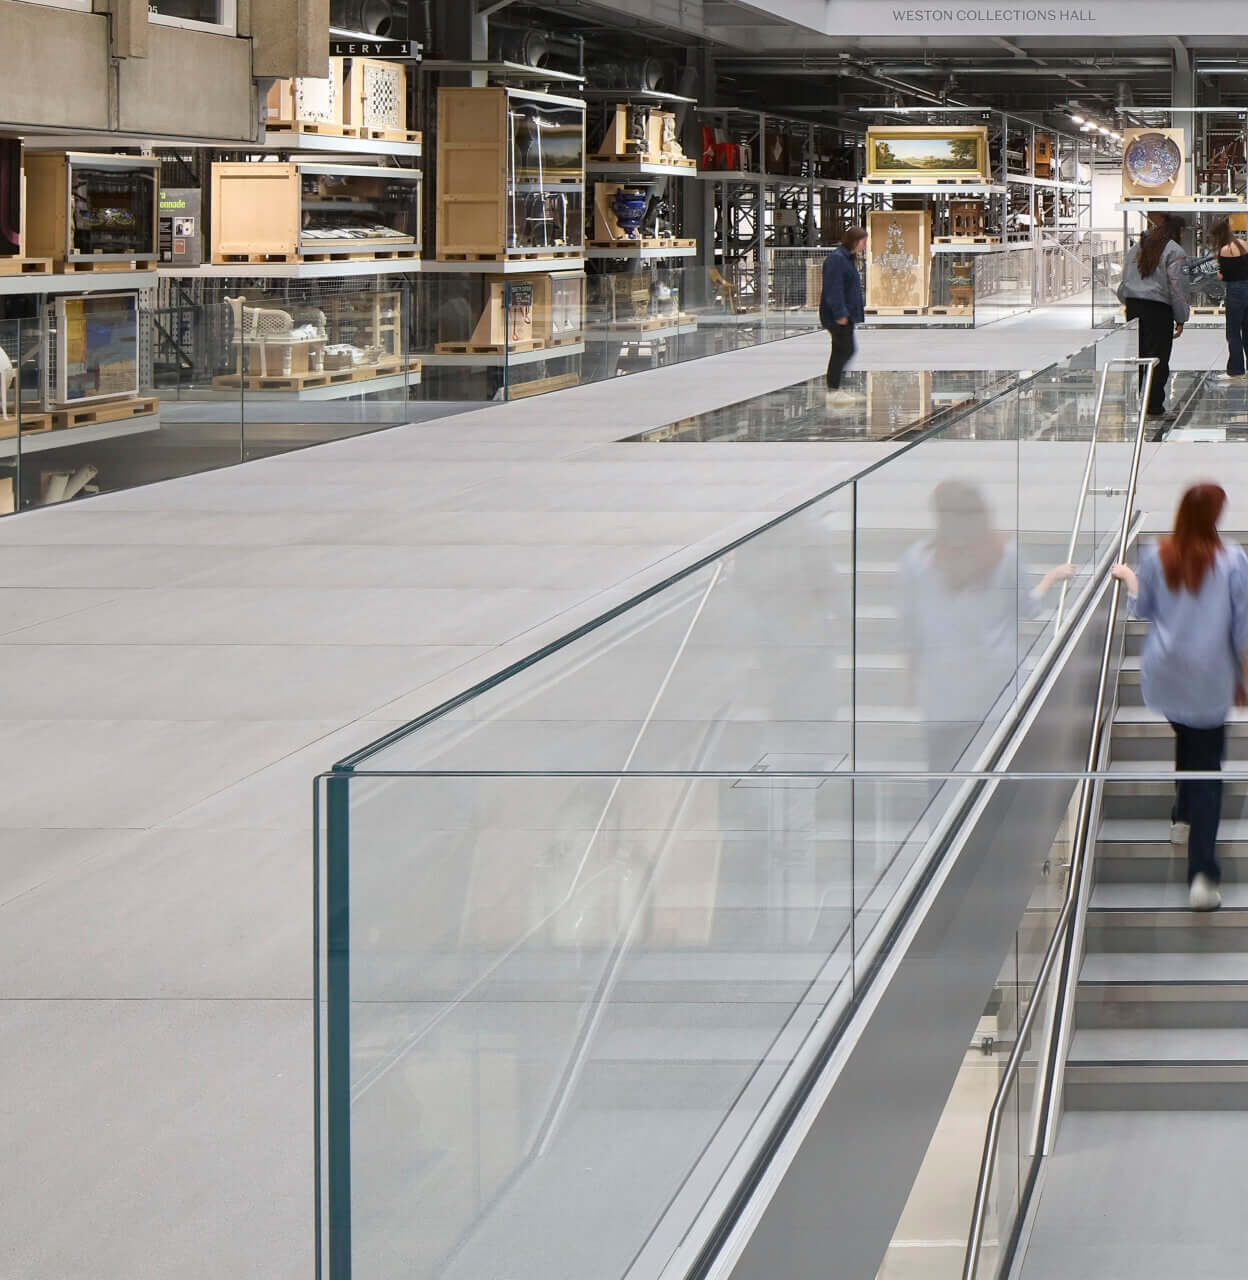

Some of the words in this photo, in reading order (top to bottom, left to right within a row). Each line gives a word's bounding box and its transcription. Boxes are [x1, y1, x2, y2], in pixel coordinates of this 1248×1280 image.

[892, 9, 953, 21] WESTON
[956, 9, 1056, 21] COLLECTIONS
[1059, 9, 1096, 21] HALL
[335, 43, 382, 53] LERY
[400, 43, 408, 53] 1
